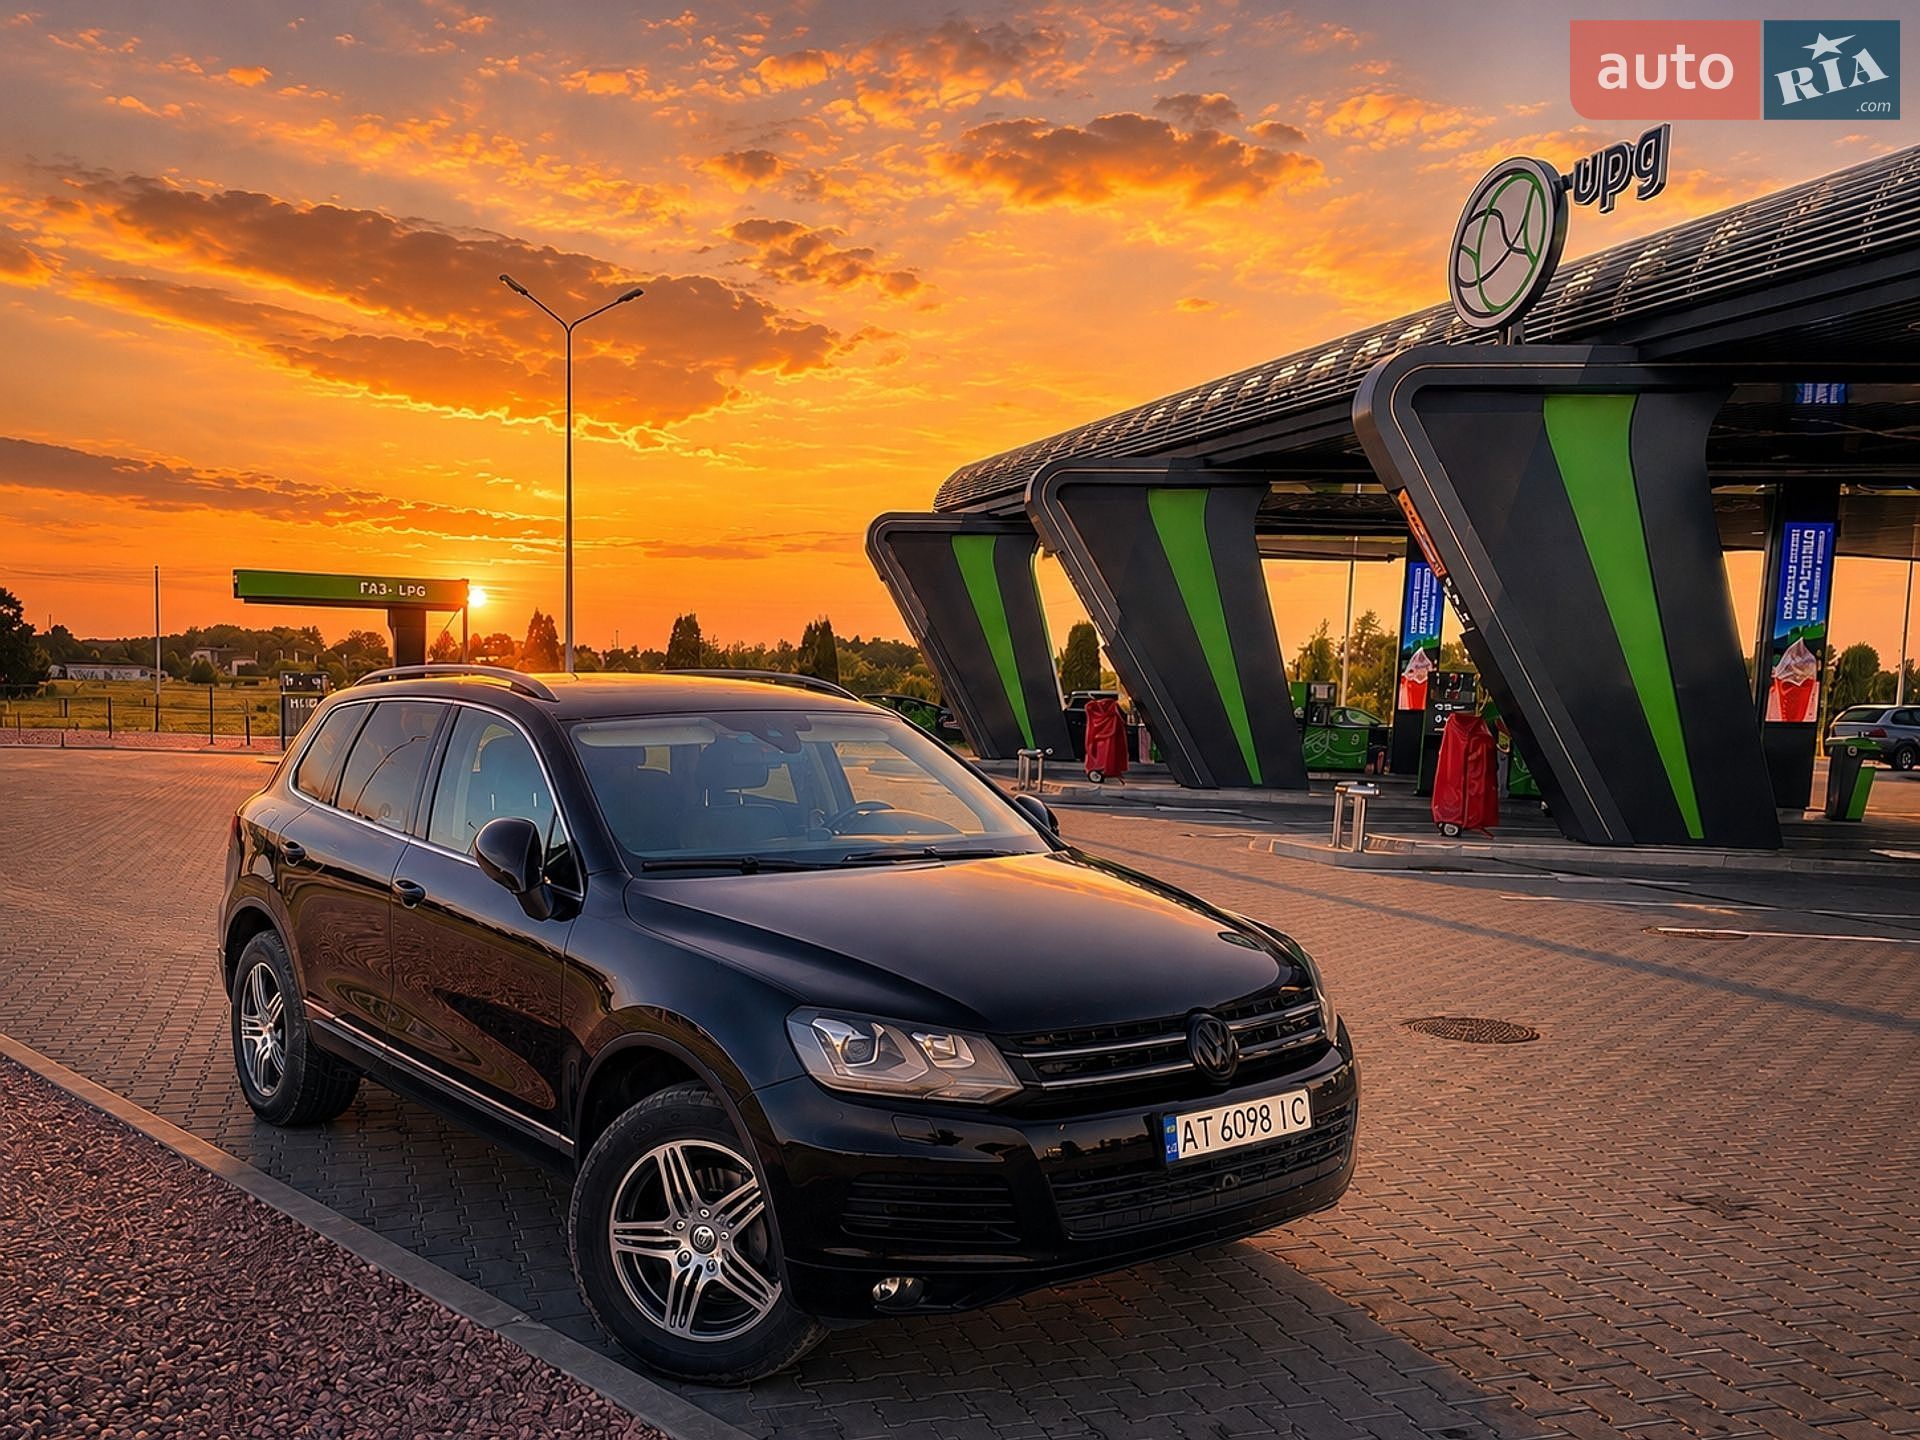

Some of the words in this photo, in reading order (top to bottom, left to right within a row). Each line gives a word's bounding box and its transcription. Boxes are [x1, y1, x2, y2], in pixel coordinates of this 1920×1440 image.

[1574, 123, 1670, 213] upg
[399, 584, 426, 597] LPG
[1182, 1115, 1213, 1153] AT
[1221, 1104, 1273, 1142] 6098
[1280, 1097, 1306, 1130] IC
